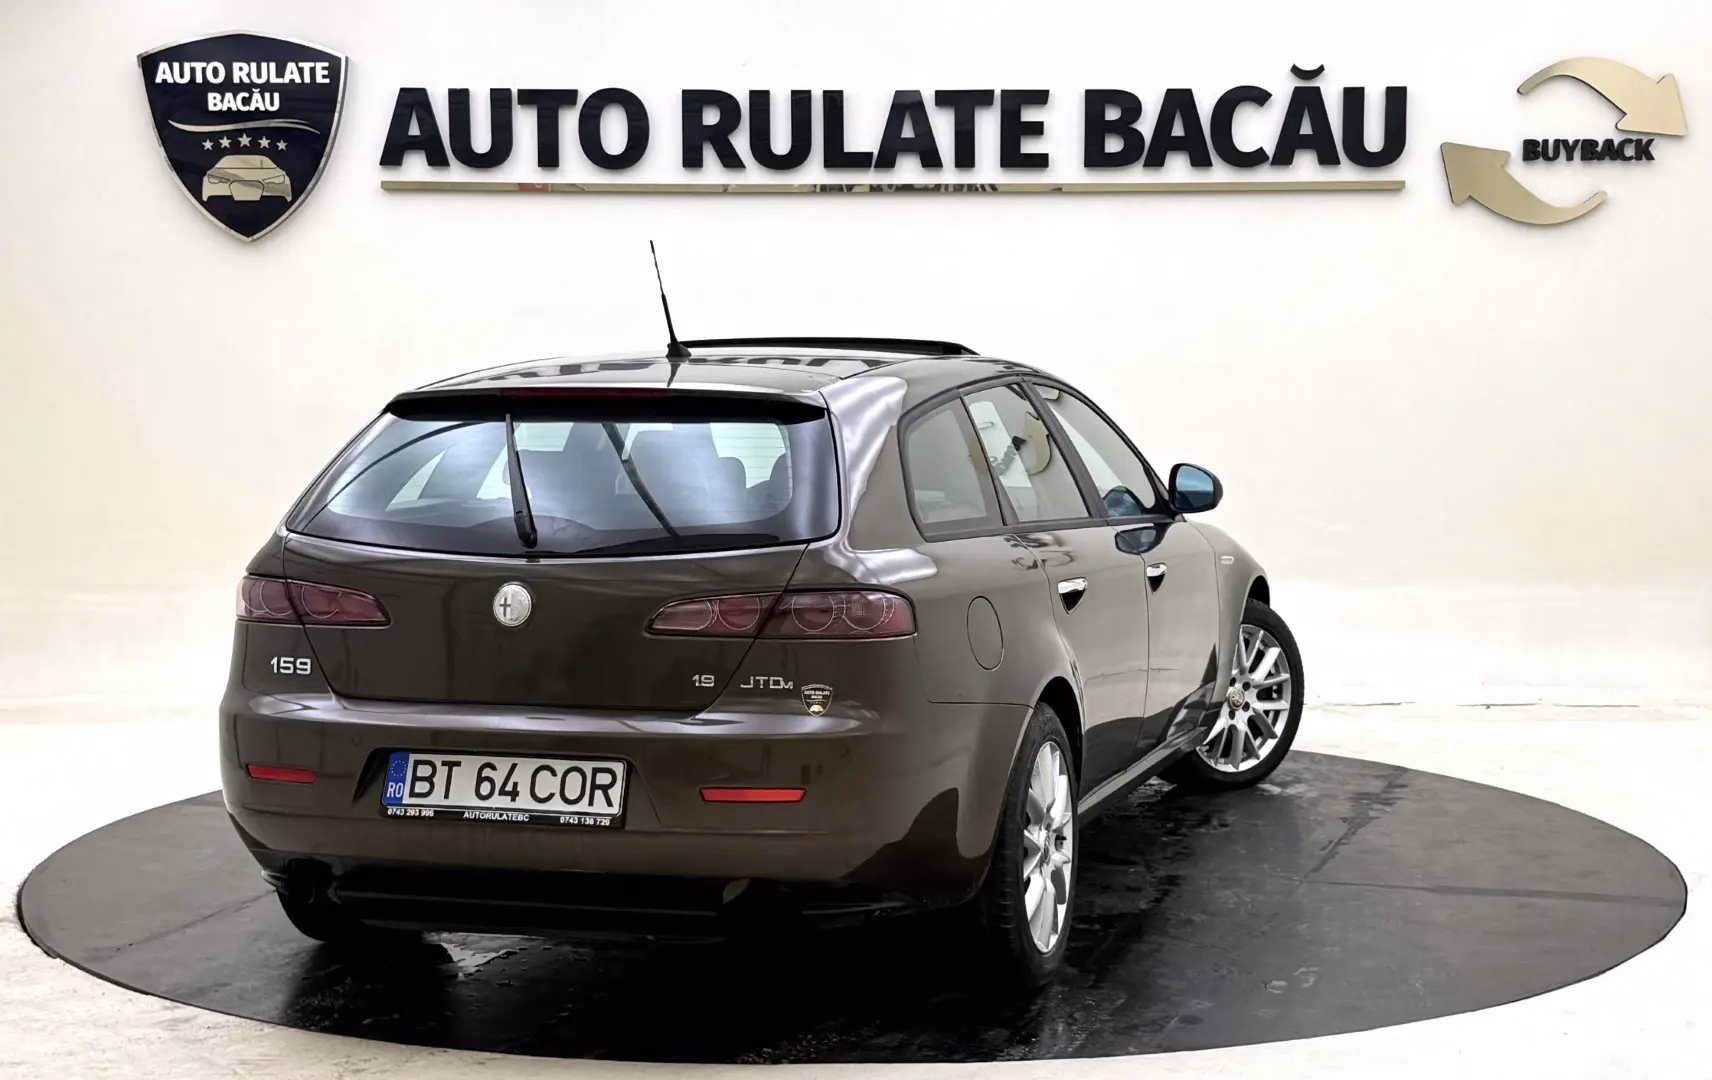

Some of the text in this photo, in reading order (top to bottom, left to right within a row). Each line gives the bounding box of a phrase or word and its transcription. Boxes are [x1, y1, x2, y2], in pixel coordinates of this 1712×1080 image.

[155, 61, 330, 84] AUTO RULATE
[207, 88, 280, 112] BACĂU
[379, 63, 1407, 170] AUTO RULATE BACĂU
[1522, 138, 1656, 162] BUYBACK
[270, 656, 311, 675] 159
[386, 782, 404, 798] RO
[408, 759, 618, 808] BT 64 COR
[463, 810, 530, 822] AUTORULATEBC
[560, 816, 579, 825] 0743
